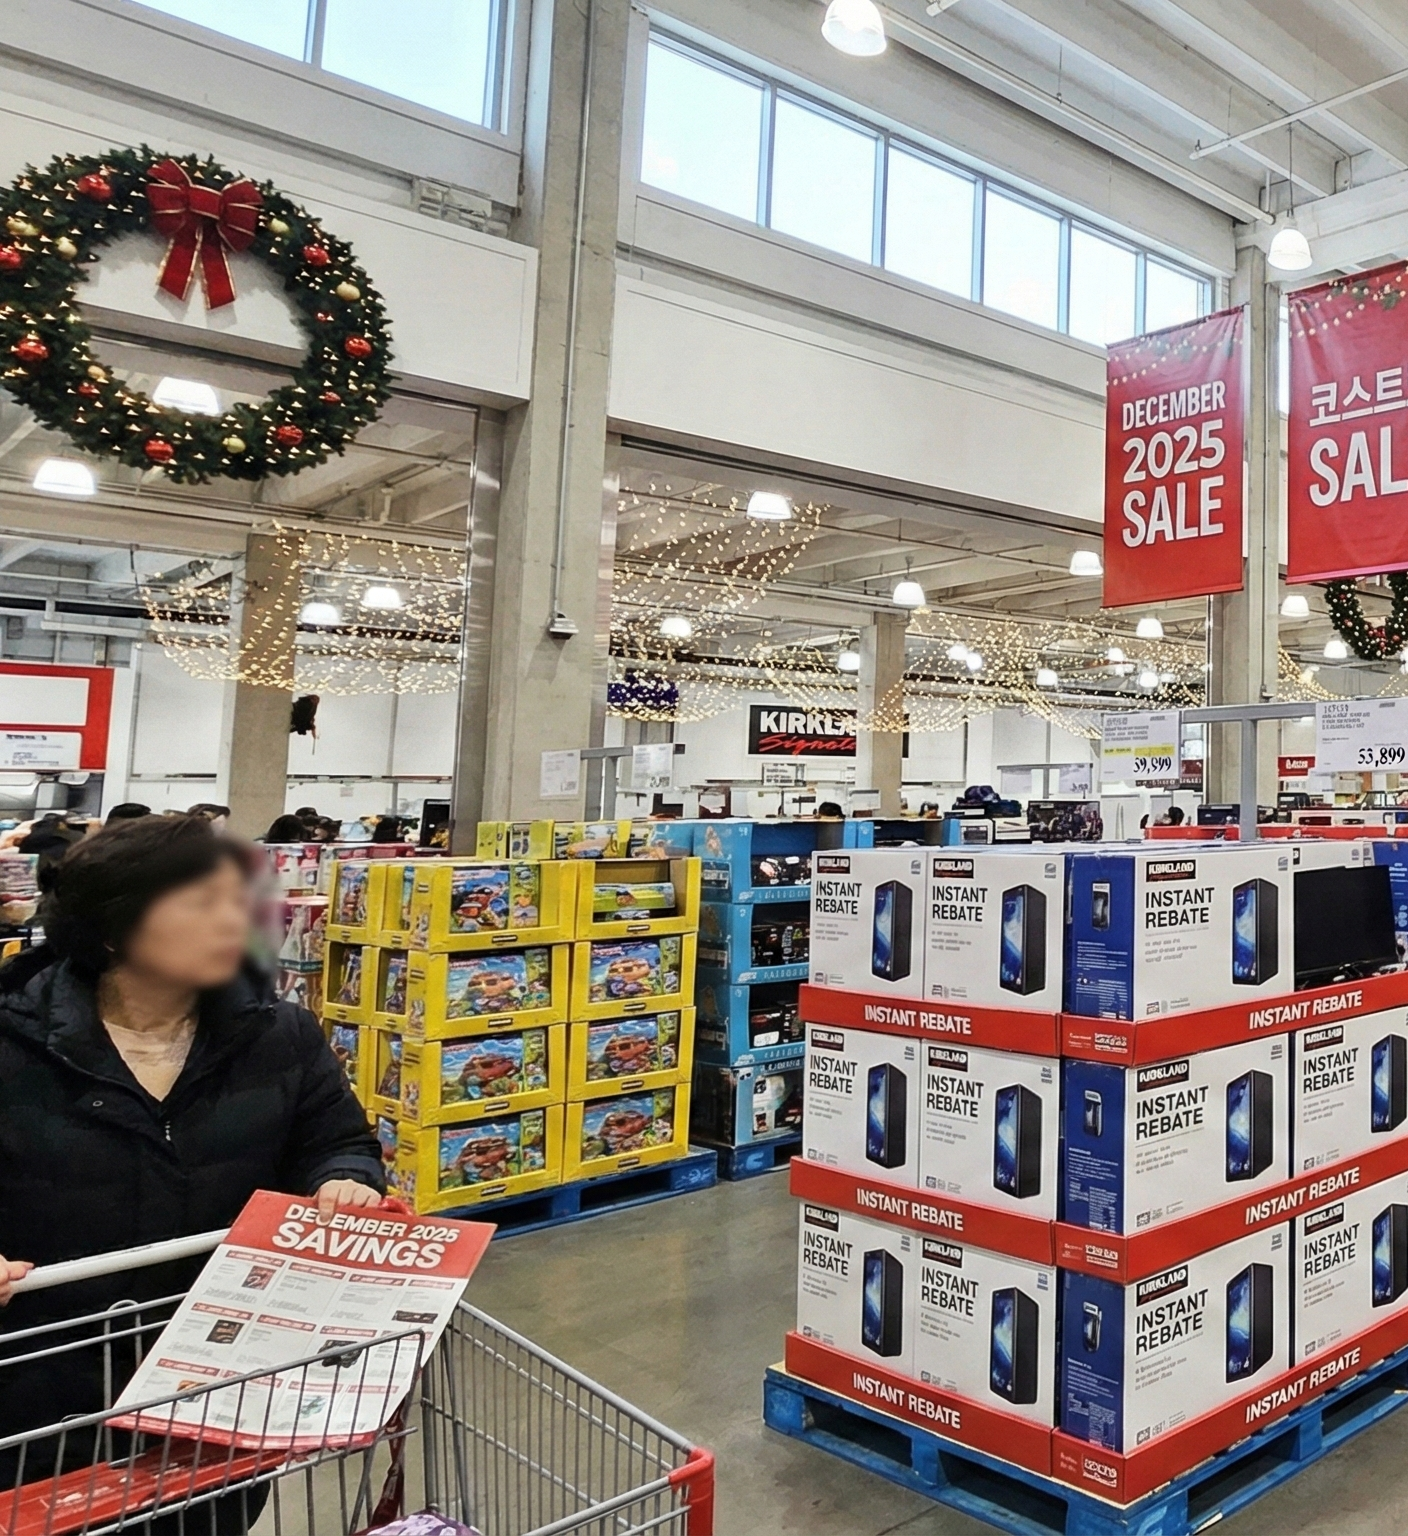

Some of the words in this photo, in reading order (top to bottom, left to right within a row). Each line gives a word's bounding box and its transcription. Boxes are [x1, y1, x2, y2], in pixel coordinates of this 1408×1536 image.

[1123, 380, 1226, 431] DECEMBER
[1123, 419, 1225, 484] 2025
[1123, 475, 1224, 548] SALE
[815, 880, 862, 898] INSTANT
[932, 886, 988, 903] INSTANT
[1145, 887, 1215, 909] INSTANT
[932, 903, 983, 922] REBATE
[1145, 907, 1210, 929] REBATE
[865, 1005, 916, 1027] INSTANT
[919, 1011, 972, 1035] REBATE
[1249, 1002, 1310, 1030] INSTANT
[1312, 989, 1363, 1015] REBATE
[809, 1054, 858, 1077] INSTANT
[1303, 1047, 1359, 1075] INSTANT
[809, 1072, 853, 1094] REBATE
[927, 1074, 984, 1099] INSTANT
[1303, 1068, 1355, 1094] REBATE
[927, 1093, 979, 1118] REBATE
[1136, 1085, 1209, 1119] INSTANT
[1135, 1106, 1203, 1141] REBATE
[856, 1188, 908, 1217] INSTANT
[911, 1202, 964, 1232] REBATE
[1245, 1187, 1307, 1225] INSTANT
[1309, 1166, 1360, 1201] REBATE
[272, 1221, 446, 1269] SAVINGS
[412, 1224, 461, 1243] 2025
[803, 1230, 853, 1259] INSTANT
[1304, 1222, 1360, 1260] INSTANT
[803, 1248, 849, 1276] REBATE
[1304, 1243, 1356, 1280] REBATE
[922, 1266, 979, 1298] INSTANT
[921, 1286, 974, 1317] REBATE
[1136, 1288, 1209, 1335] INSTANT
[1135, 1313, 1203, 1356] REBATE
[853, 1372, 905, 1407] INSTANT
[908, 1393, 961, 1429] REBATE
[1245, 1381, 1307, 1424] INSTANT
[1309, 1346, 1361, 1390] REBATE
